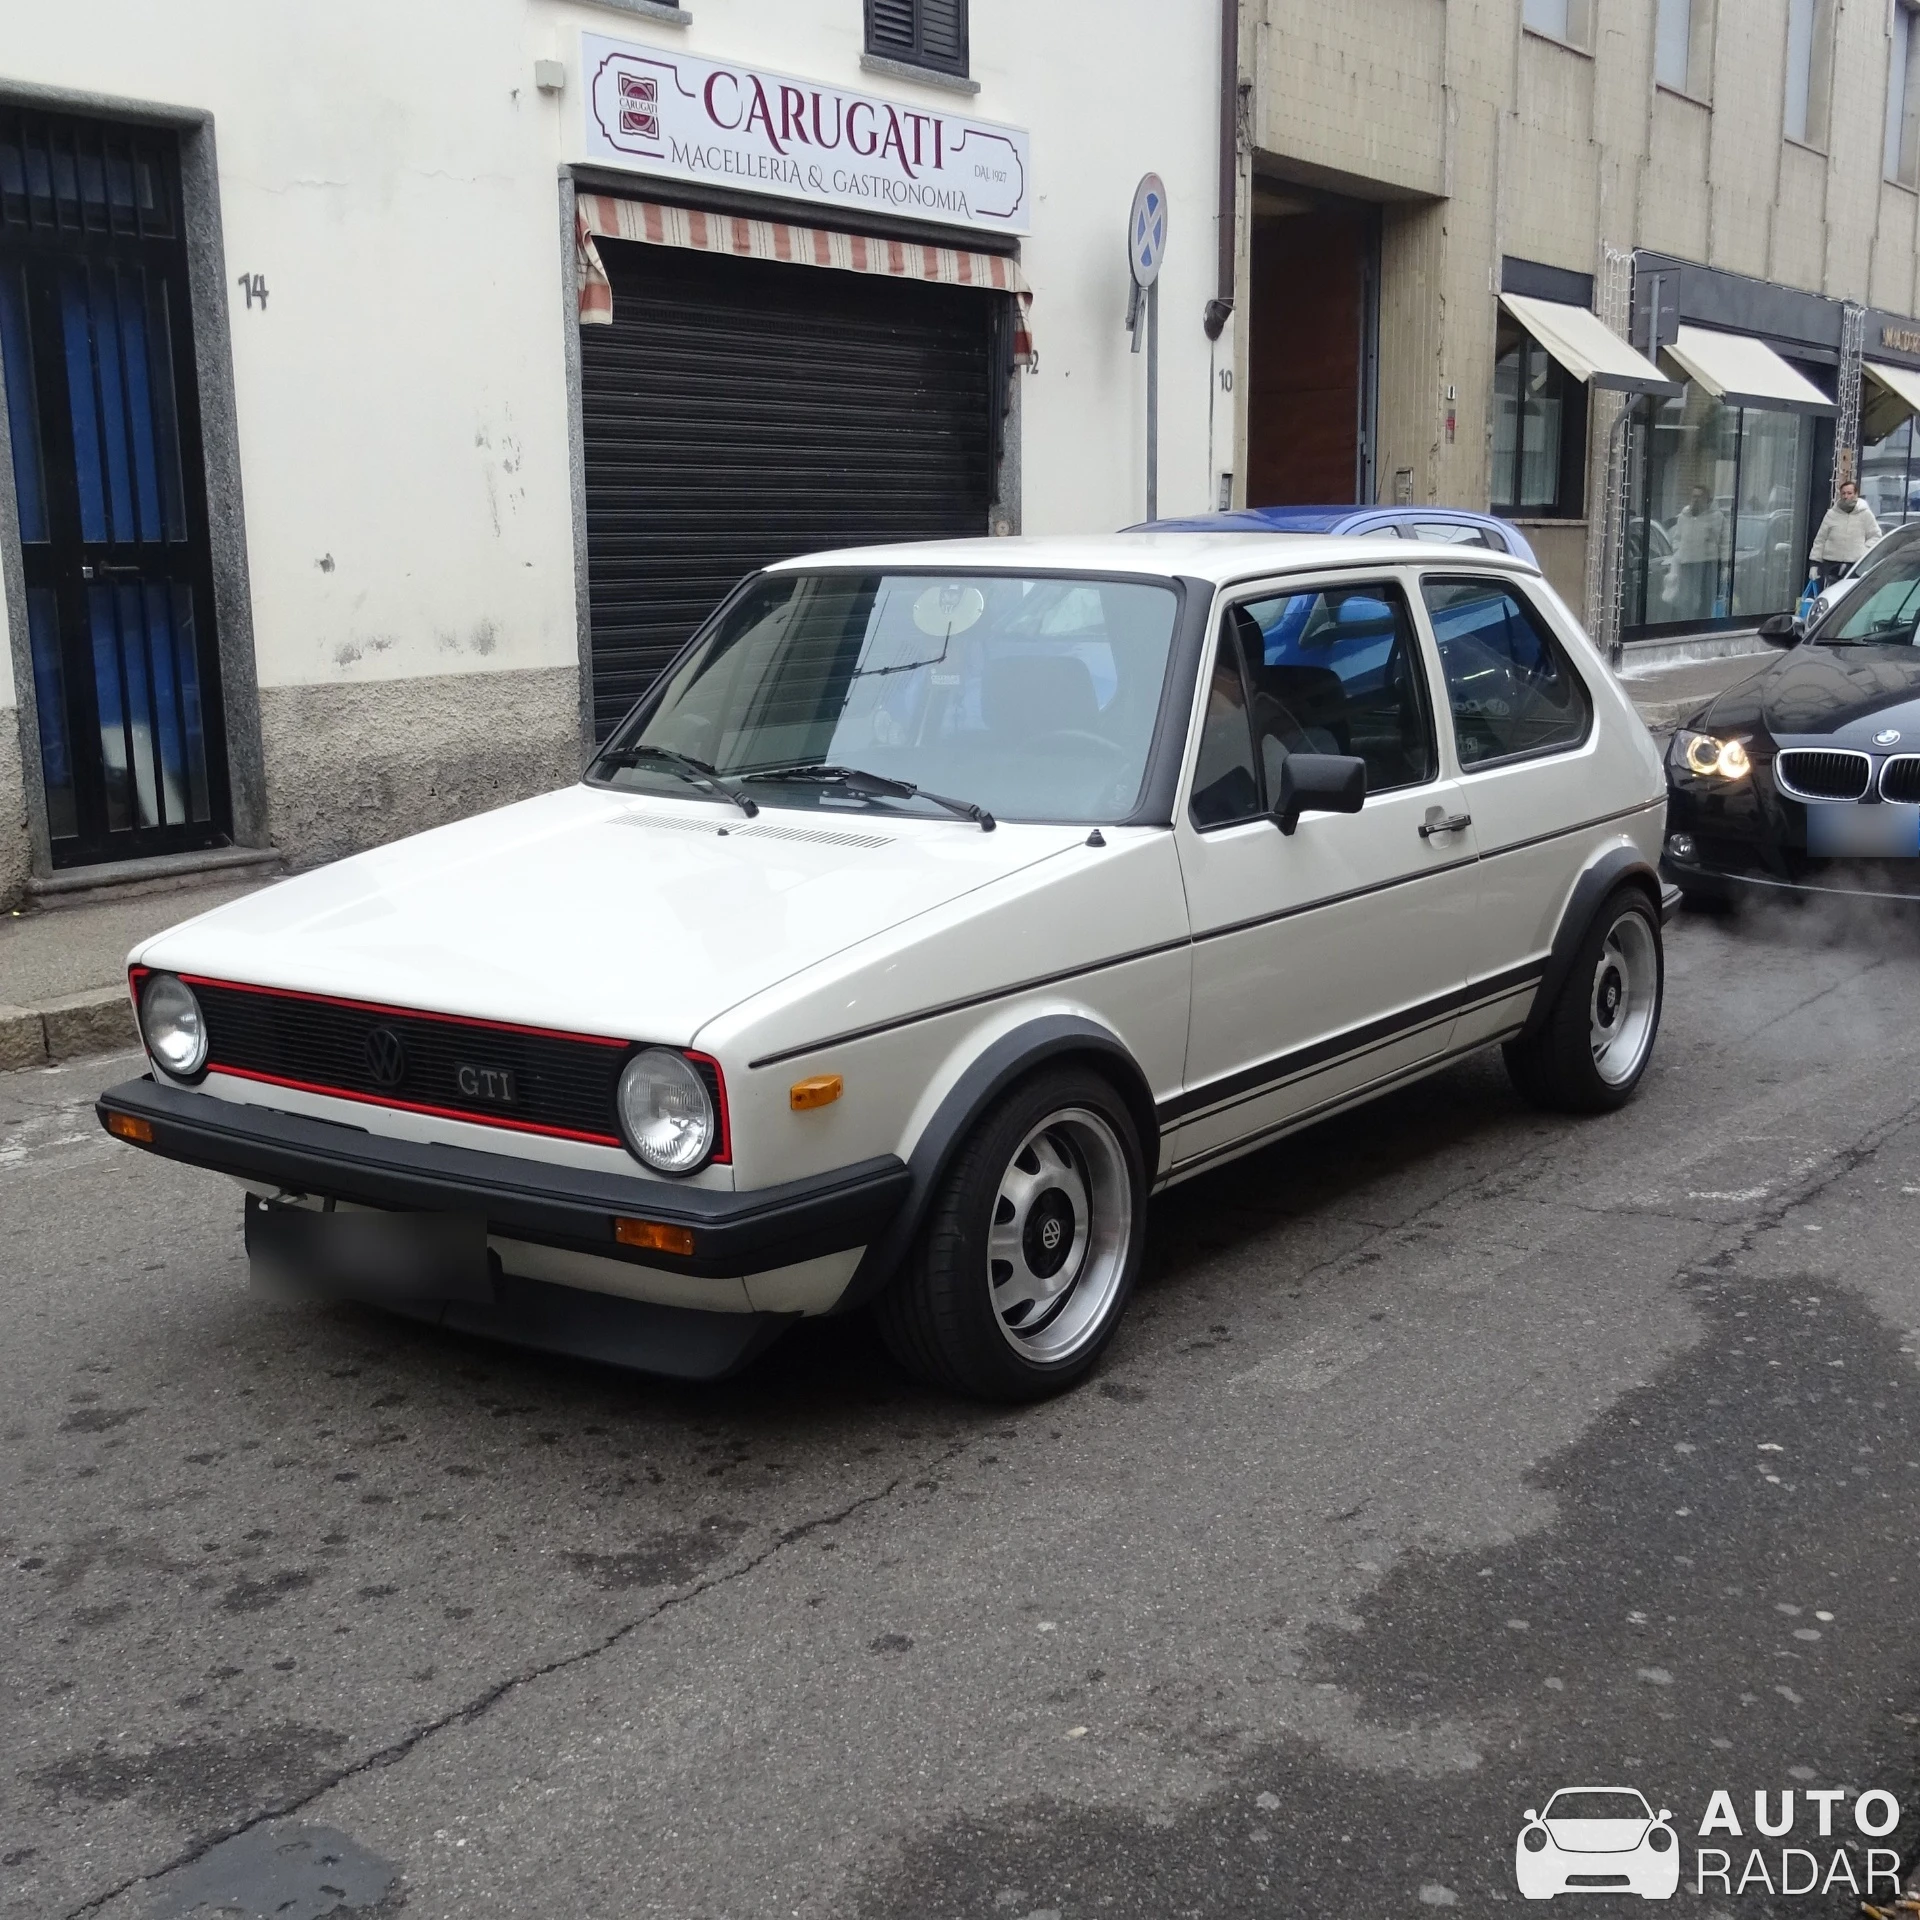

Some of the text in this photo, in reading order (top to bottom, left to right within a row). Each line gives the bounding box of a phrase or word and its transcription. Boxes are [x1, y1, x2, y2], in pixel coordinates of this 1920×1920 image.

[620, 98, 658, 114] CARUGATI
[703, 71, 945, 179] CARUGATI
[669, 136, 973, 219] MACELLERIA & GASTRONOMIA
[974, 164, 1007, 184] DAL 1927
[237, 271, 270, 311] 14
[1218, 368, 1233, 392] 10
[458, 1066, 512, 1101] GTI
